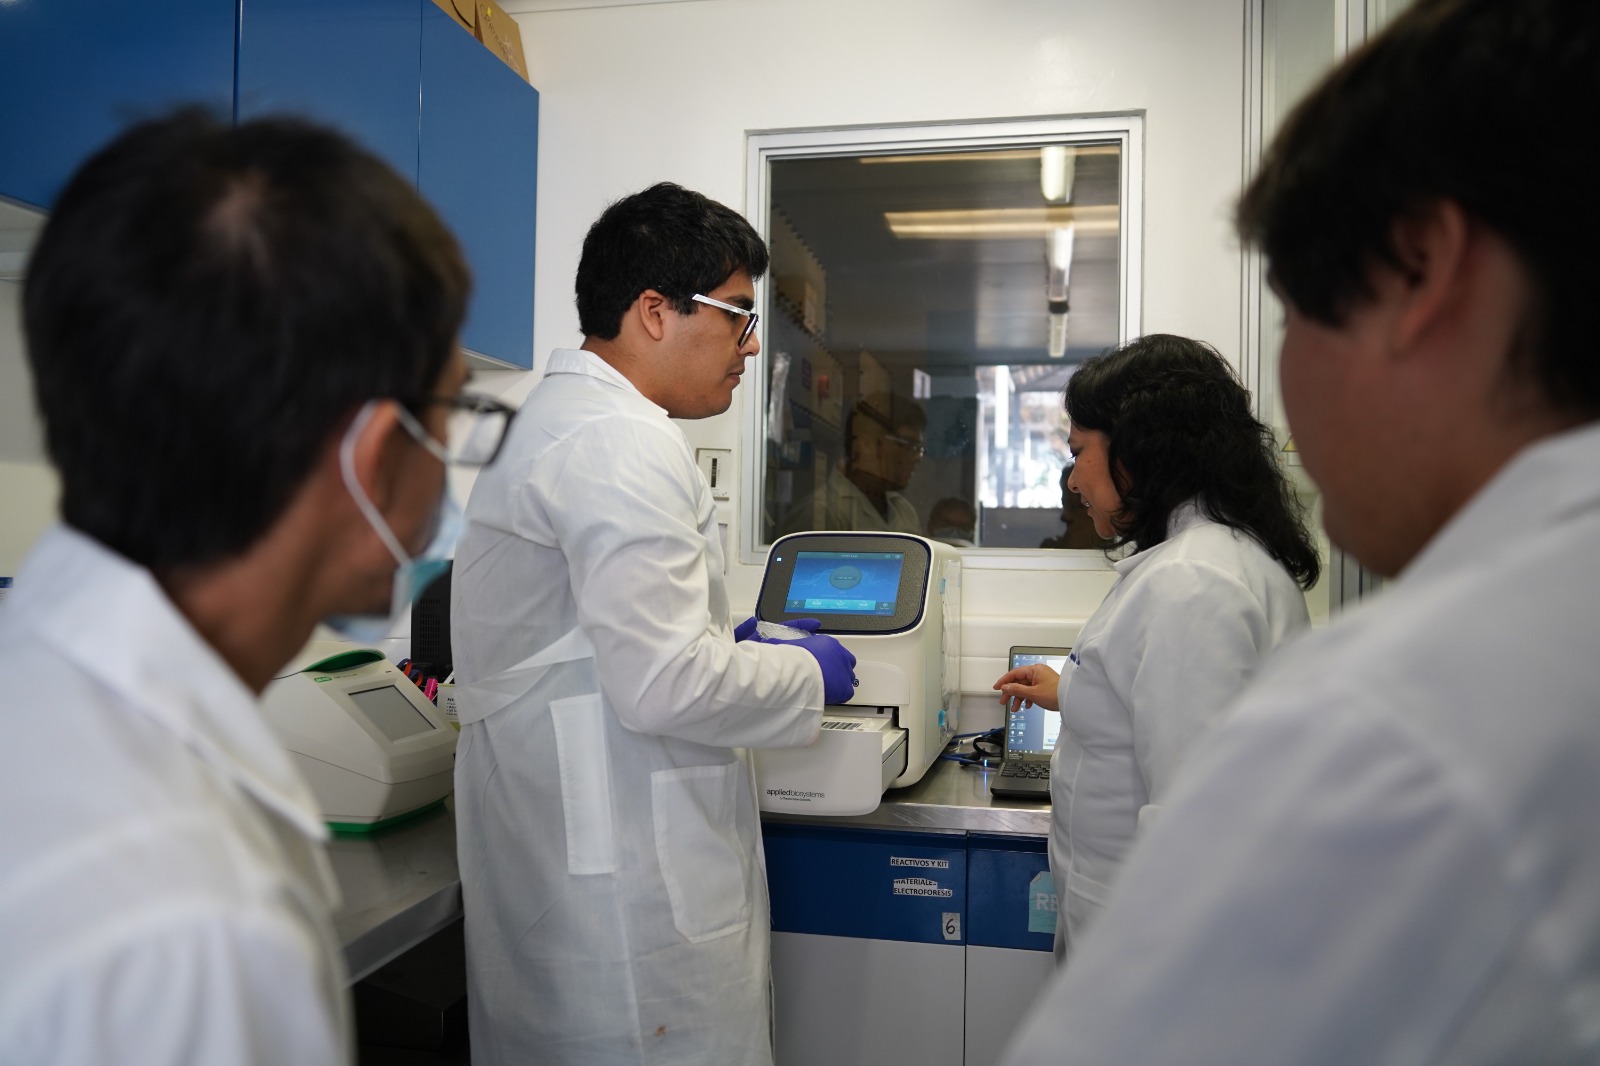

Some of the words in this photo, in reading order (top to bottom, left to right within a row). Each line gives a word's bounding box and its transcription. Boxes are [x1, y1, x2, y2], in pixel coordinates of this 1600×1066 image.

[891, 858, 930, 867] REACTIVOS
[894, 878, 937, 886] MATERIALE
[893, 887, 952, 897] ELECTROFORESIS
[945, 918, 956, 935] 6
